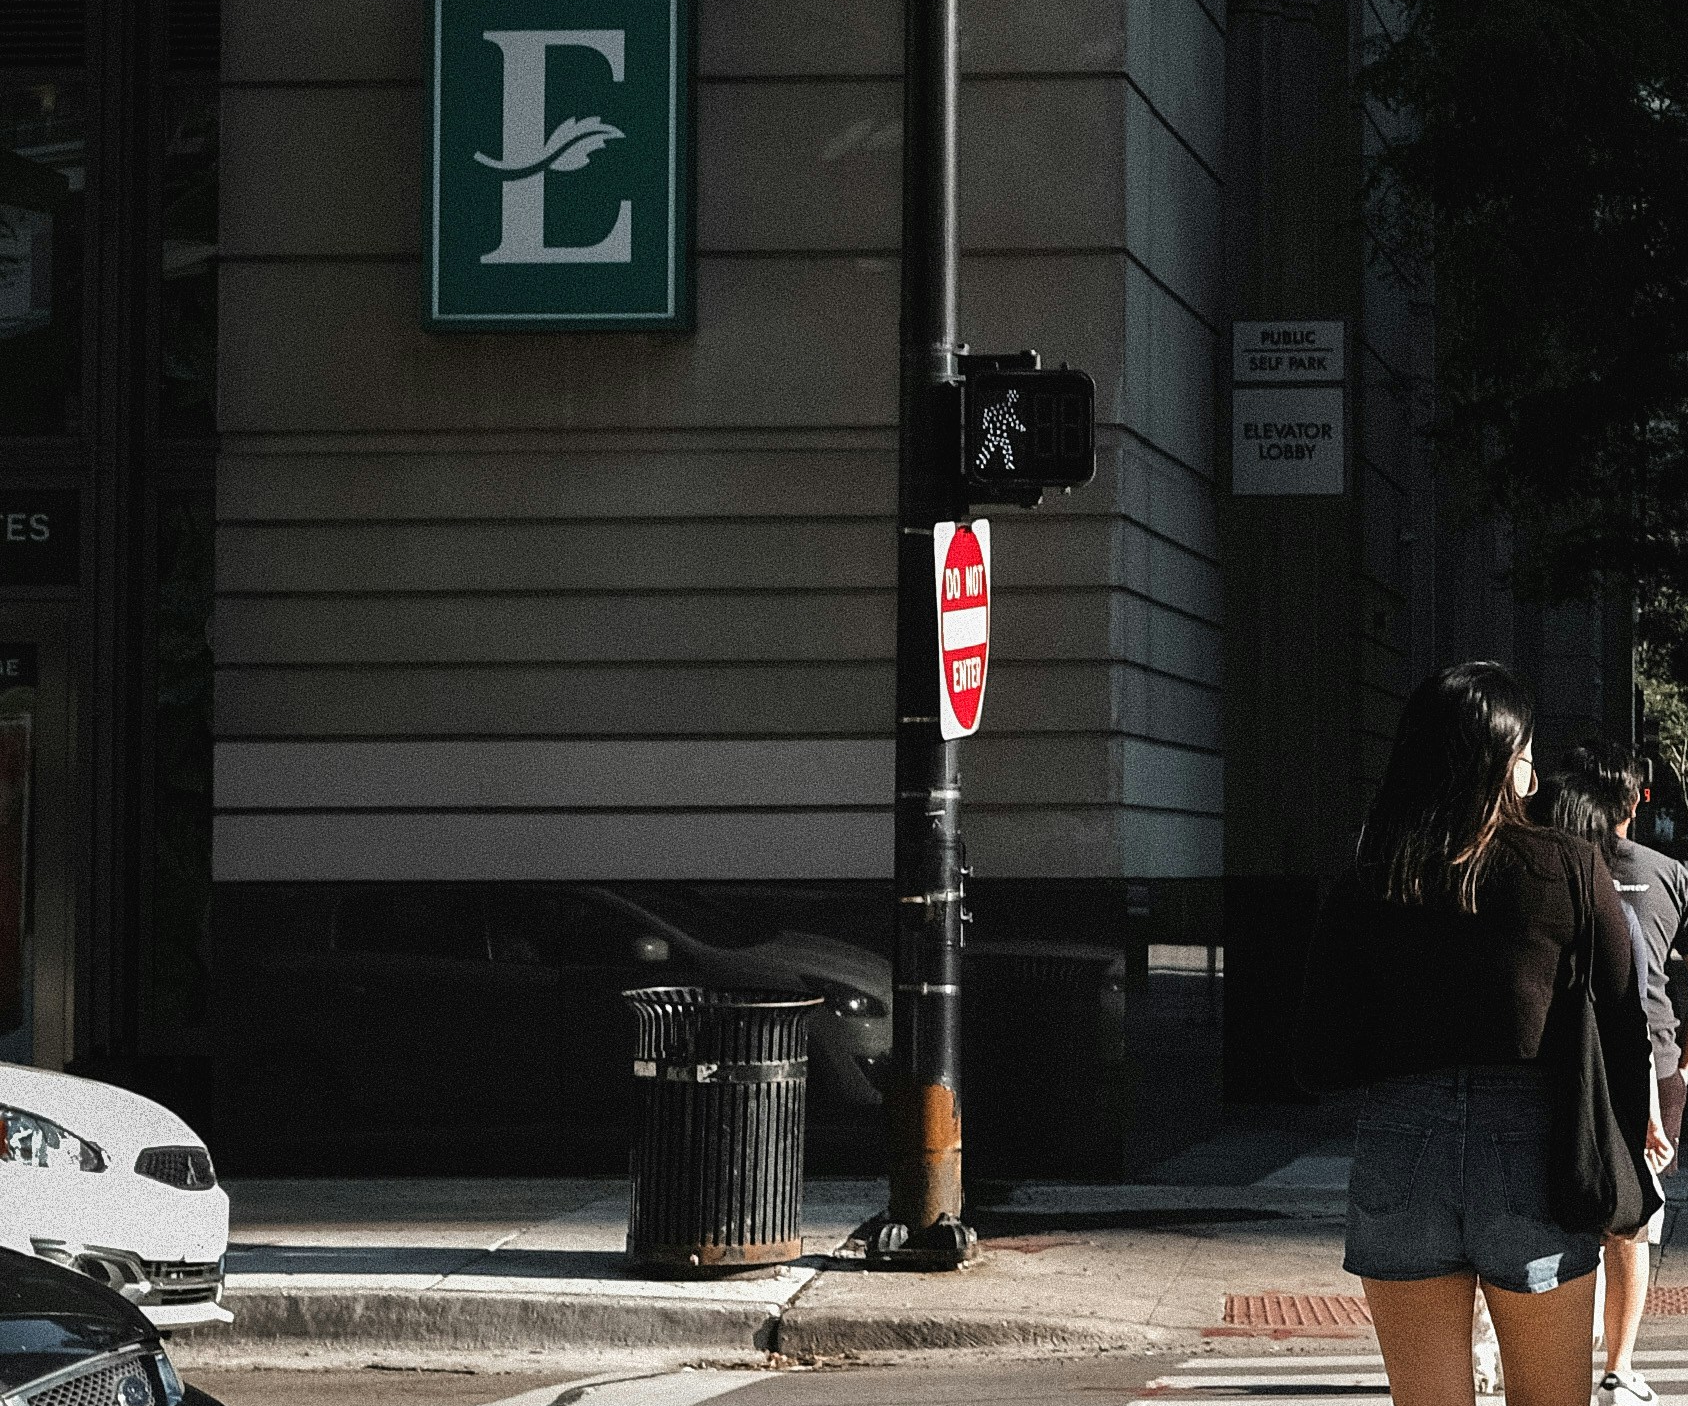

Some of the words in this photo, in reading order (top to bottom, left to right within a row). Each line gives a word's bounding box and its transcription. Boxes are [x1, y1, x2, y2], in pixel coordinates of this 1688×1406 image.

[477, 29, 632, 265] E
[1260, 329, 1317, 345] PUBLIC
[1250, 356, 1284, 371] SELF
[1288, 356, 1328, 371] PARK
[1243, 422, 1334, 441] ELEVATOR
[1258, 443, 1317, 460] LOBBY
[0, 513, 51, 541] ES
[945, 567, 961, 601] DO
[965, 564, 984, 597] NOT
[952, 656, 982, 693] ENTER
